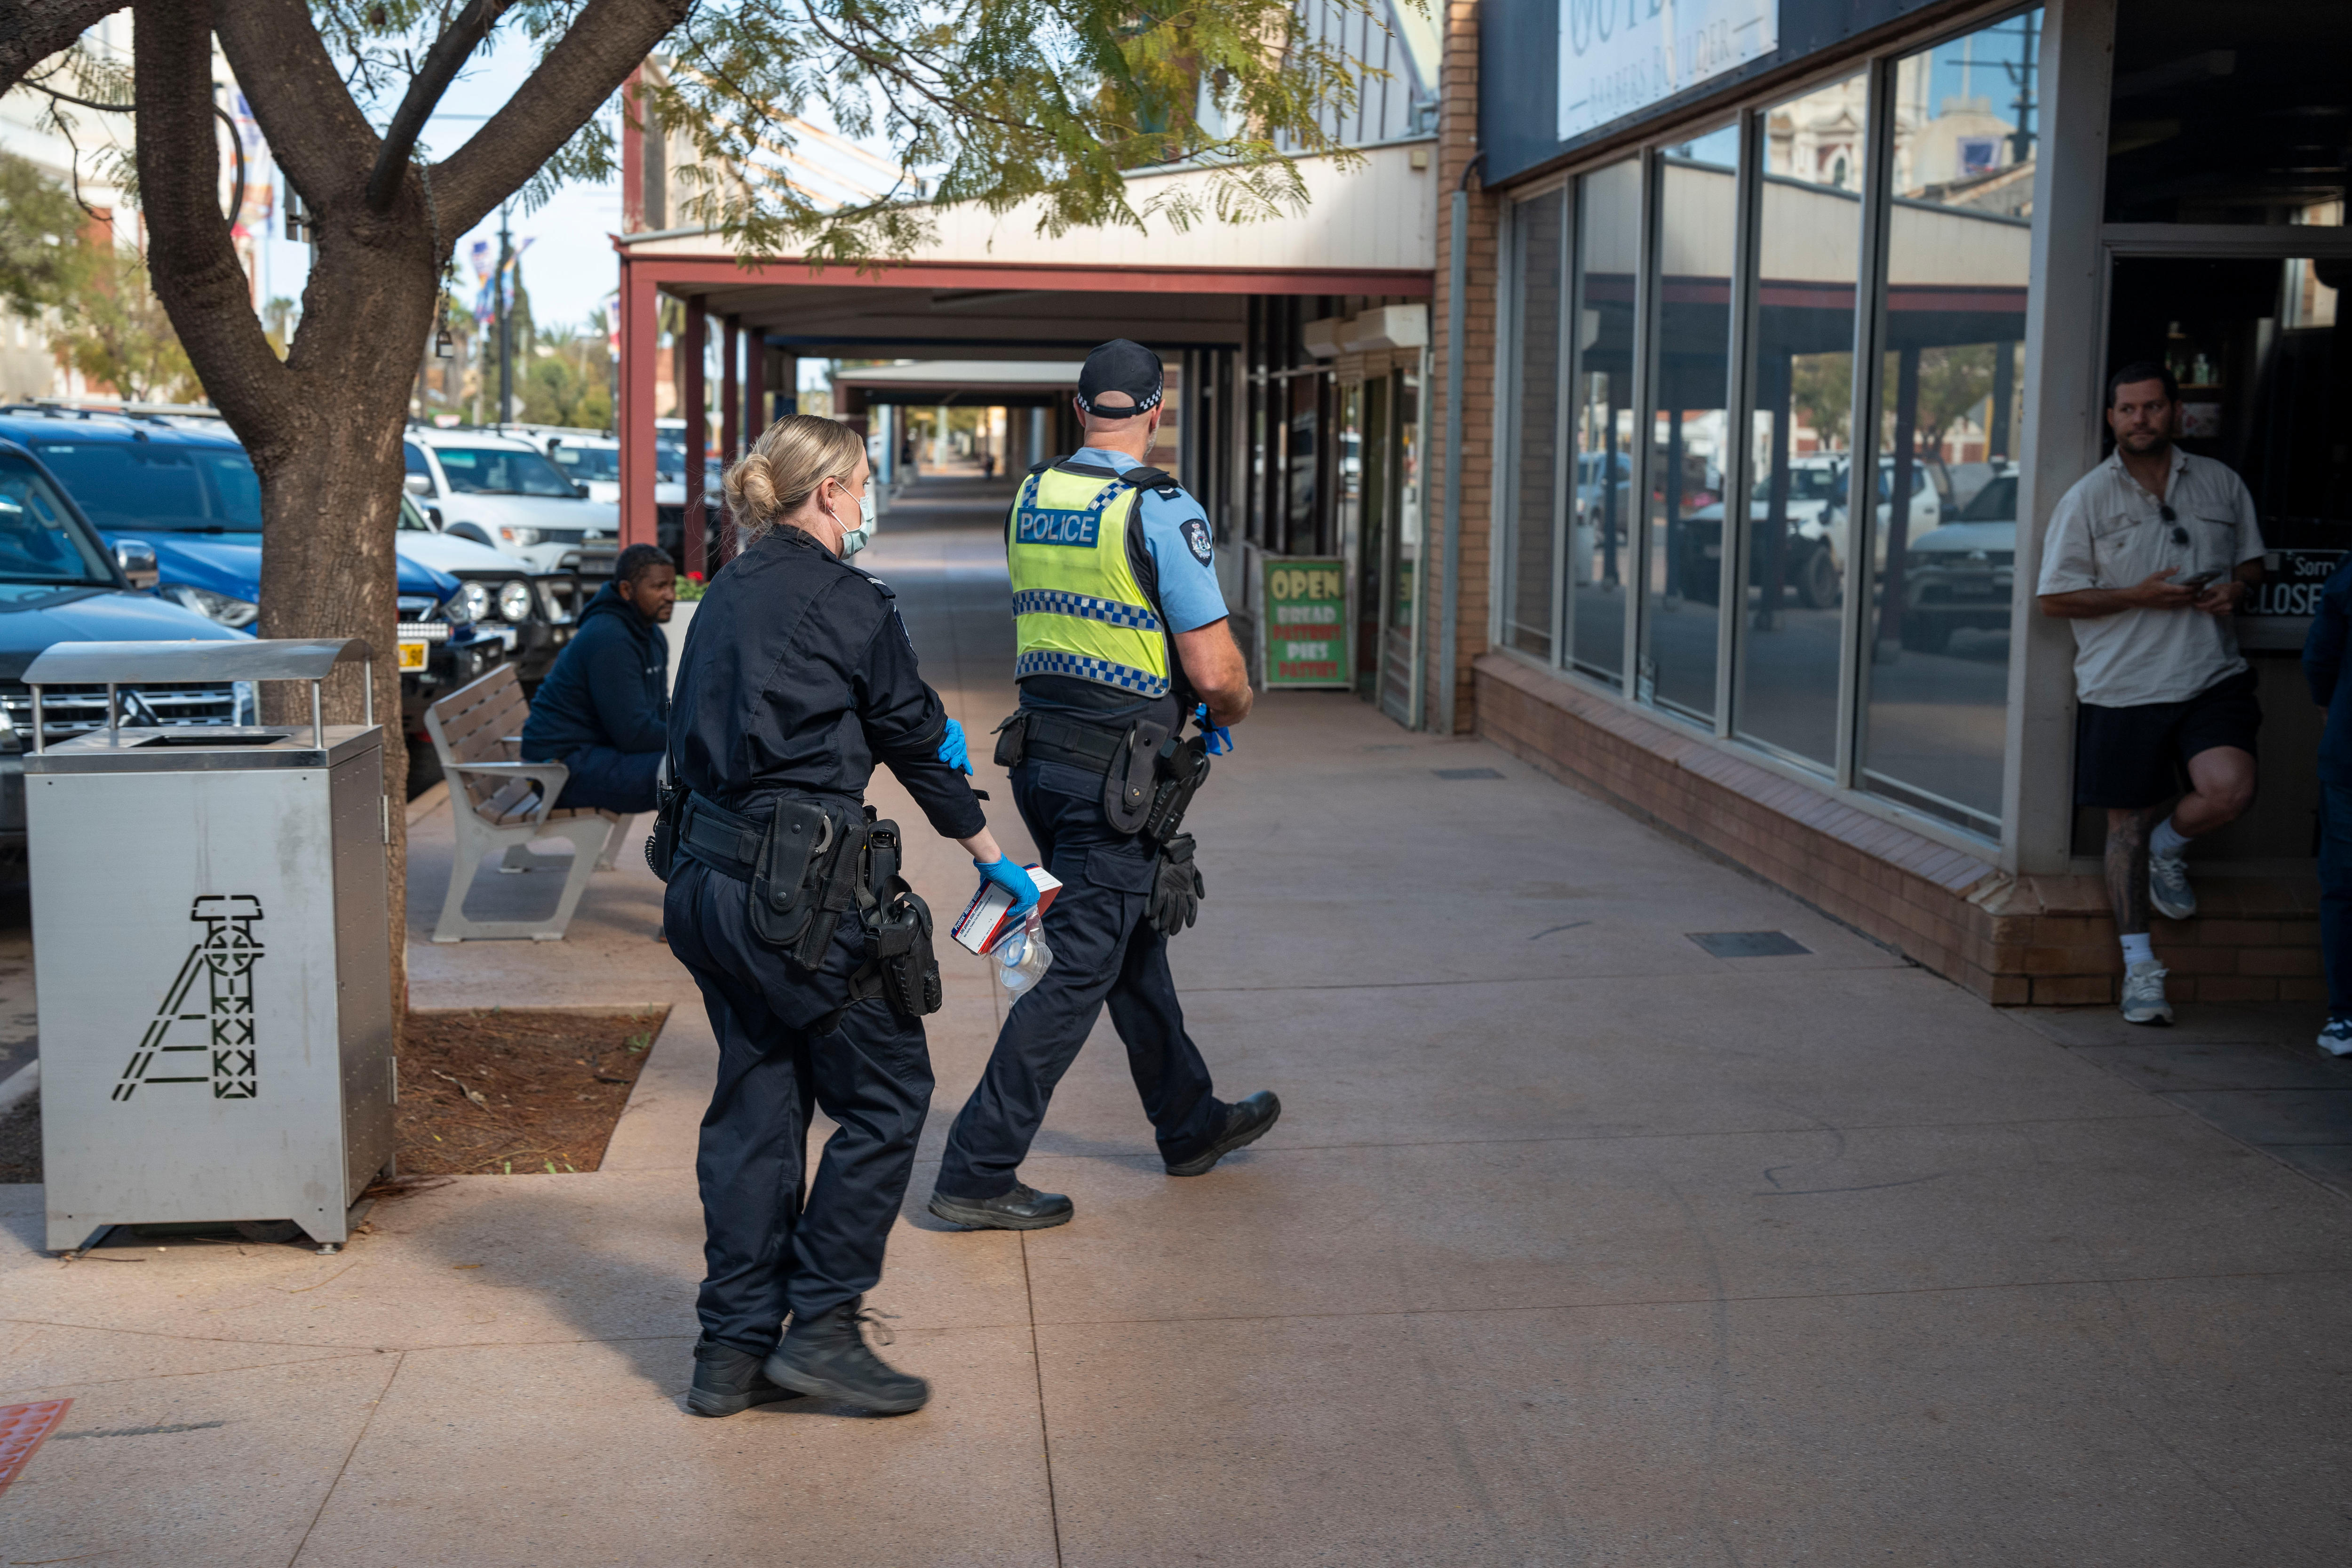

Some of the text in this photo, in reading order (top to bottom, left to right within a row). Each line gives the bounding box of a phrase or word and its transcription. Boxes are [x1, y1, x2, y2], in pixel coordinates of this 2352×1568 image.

[1020, 513, 1095, 542] POLICE
[1271, 570, 1340, 600] OPEN
[964, 900, 975, 915] Nitrile
[973, 890, 981, 901] Blue
[974, 900, 983, 913] medium
